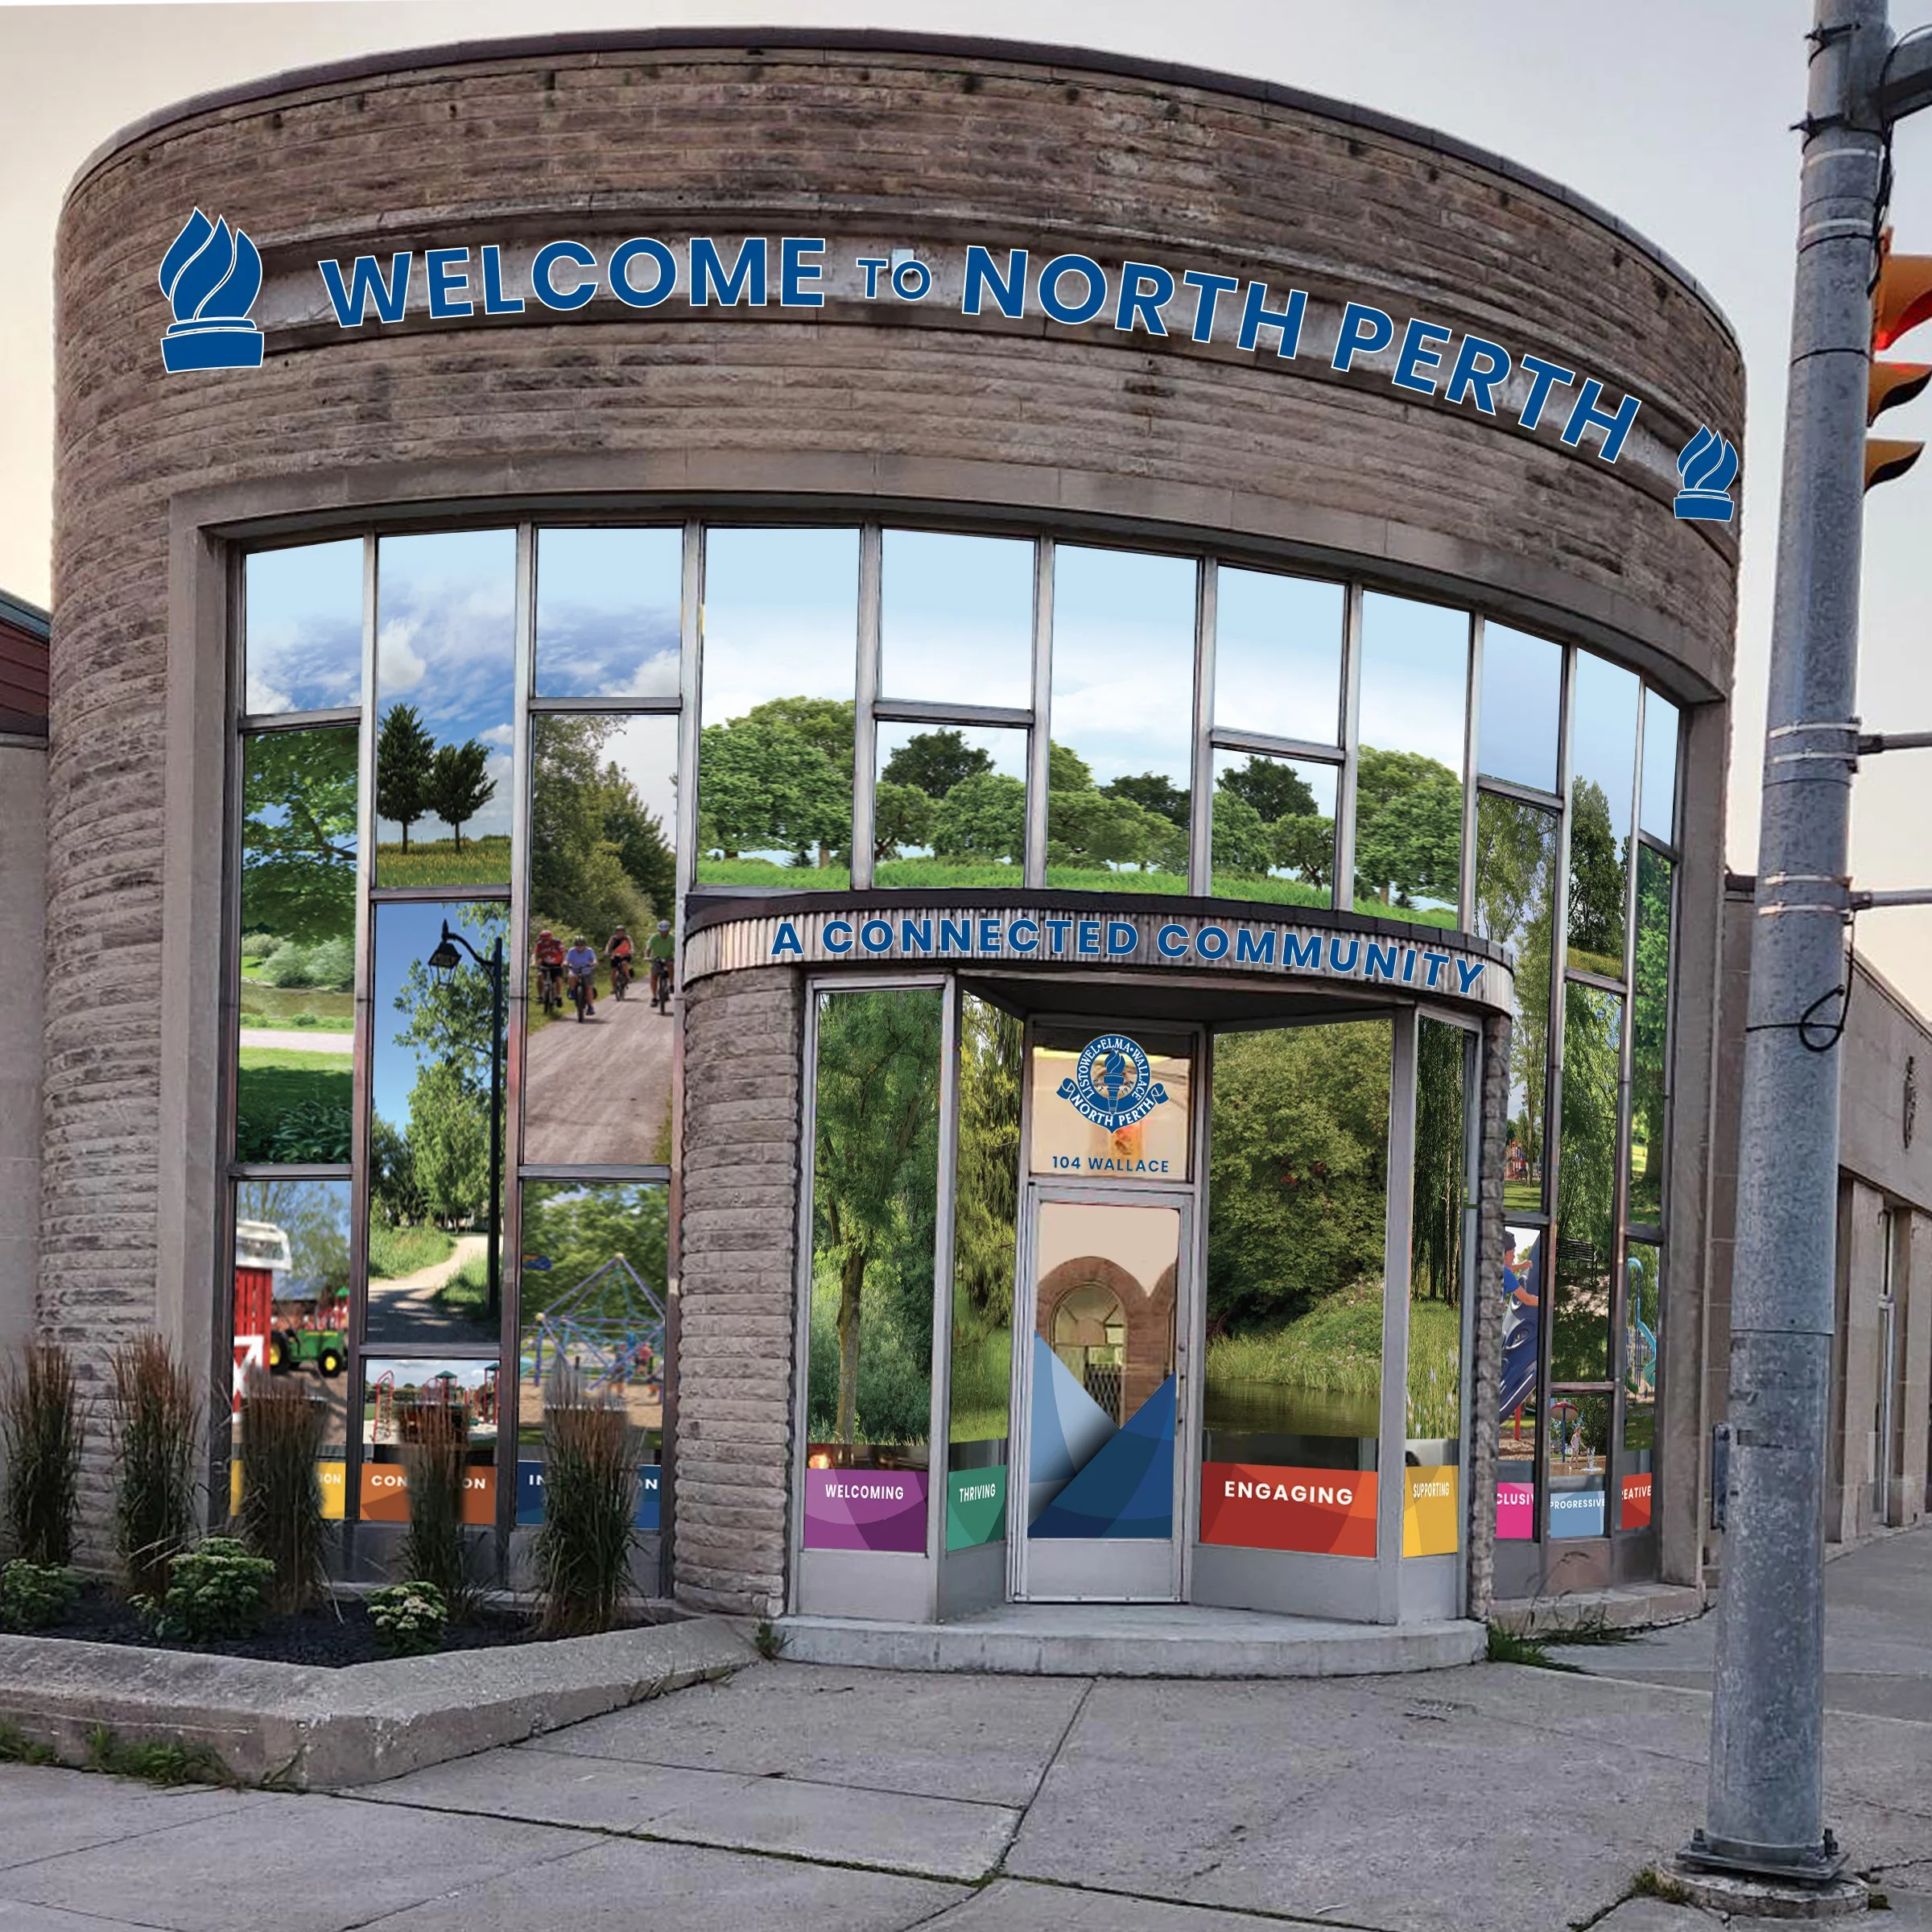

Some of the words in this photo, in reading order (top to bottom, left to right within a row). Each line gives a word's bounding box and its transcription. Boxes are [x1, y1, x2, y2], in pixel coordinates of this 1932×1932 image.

[318, 237, 825, 328] WELCOME
[857, 257, 931, 301] TO
[962, 245, 1309, 359] NORTH
[1331, 301, 1641, 464] PERTH
[770, 921, 805, 956] A
[822, 918, 1139, 956] CONNECTED
[1157, 923, 1485, 995] COMMUNITY
[1079, 1044, 1100, 1100] LISTOWEL
[1100, 1038, 1130, 1053] ELMA
[1132, 1049, 1149, 1100] WALLACE
[1071, 1093, 1113, 1126] NORTH
[1118, 1097, 1154, 1126] PERTH
[1052, 1156, 1081, 1170] 104
[1088, 1157, 1169, 1173] WALLACE
[825, 1484, 904, 1501] WELCOMING
[959, 1484, 996, 1503] THRIVING
[1224, 1480, 1353, 1505] ENGAGING
[1413, 1482, 1450, 1498] SUPPORTING
[1550, 1498, 1605, 1509] PROGRESSIVE
